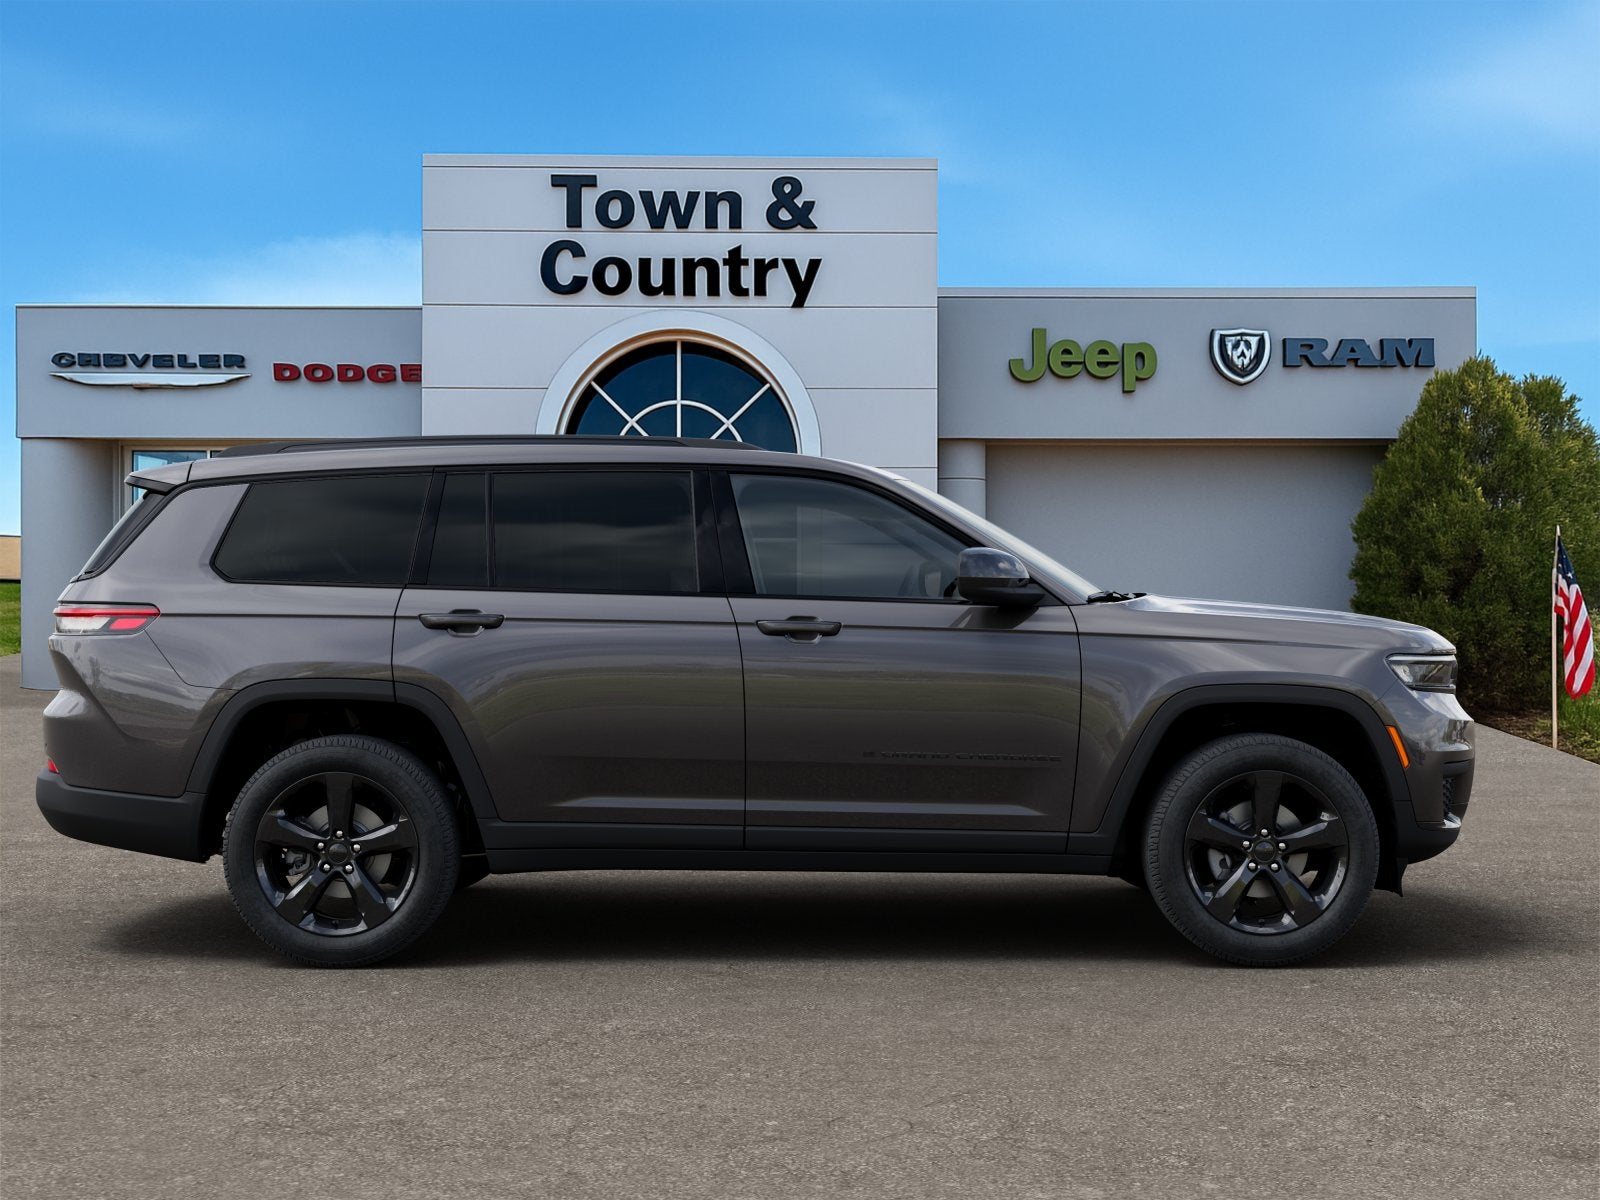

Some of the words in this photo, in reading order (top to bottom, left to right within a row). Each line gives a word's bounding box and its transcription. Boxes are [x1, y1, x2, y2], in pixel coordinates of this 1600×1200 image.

[550, 174, 743, 230] Town
[765, 176, 818, 230] &
[540, 239, 822, 309] Country
[273, 362, 422, 383] DODGE
[1008, 328, 1158, 393] Jeep
[1283, 337, 1436, 368] RAM
